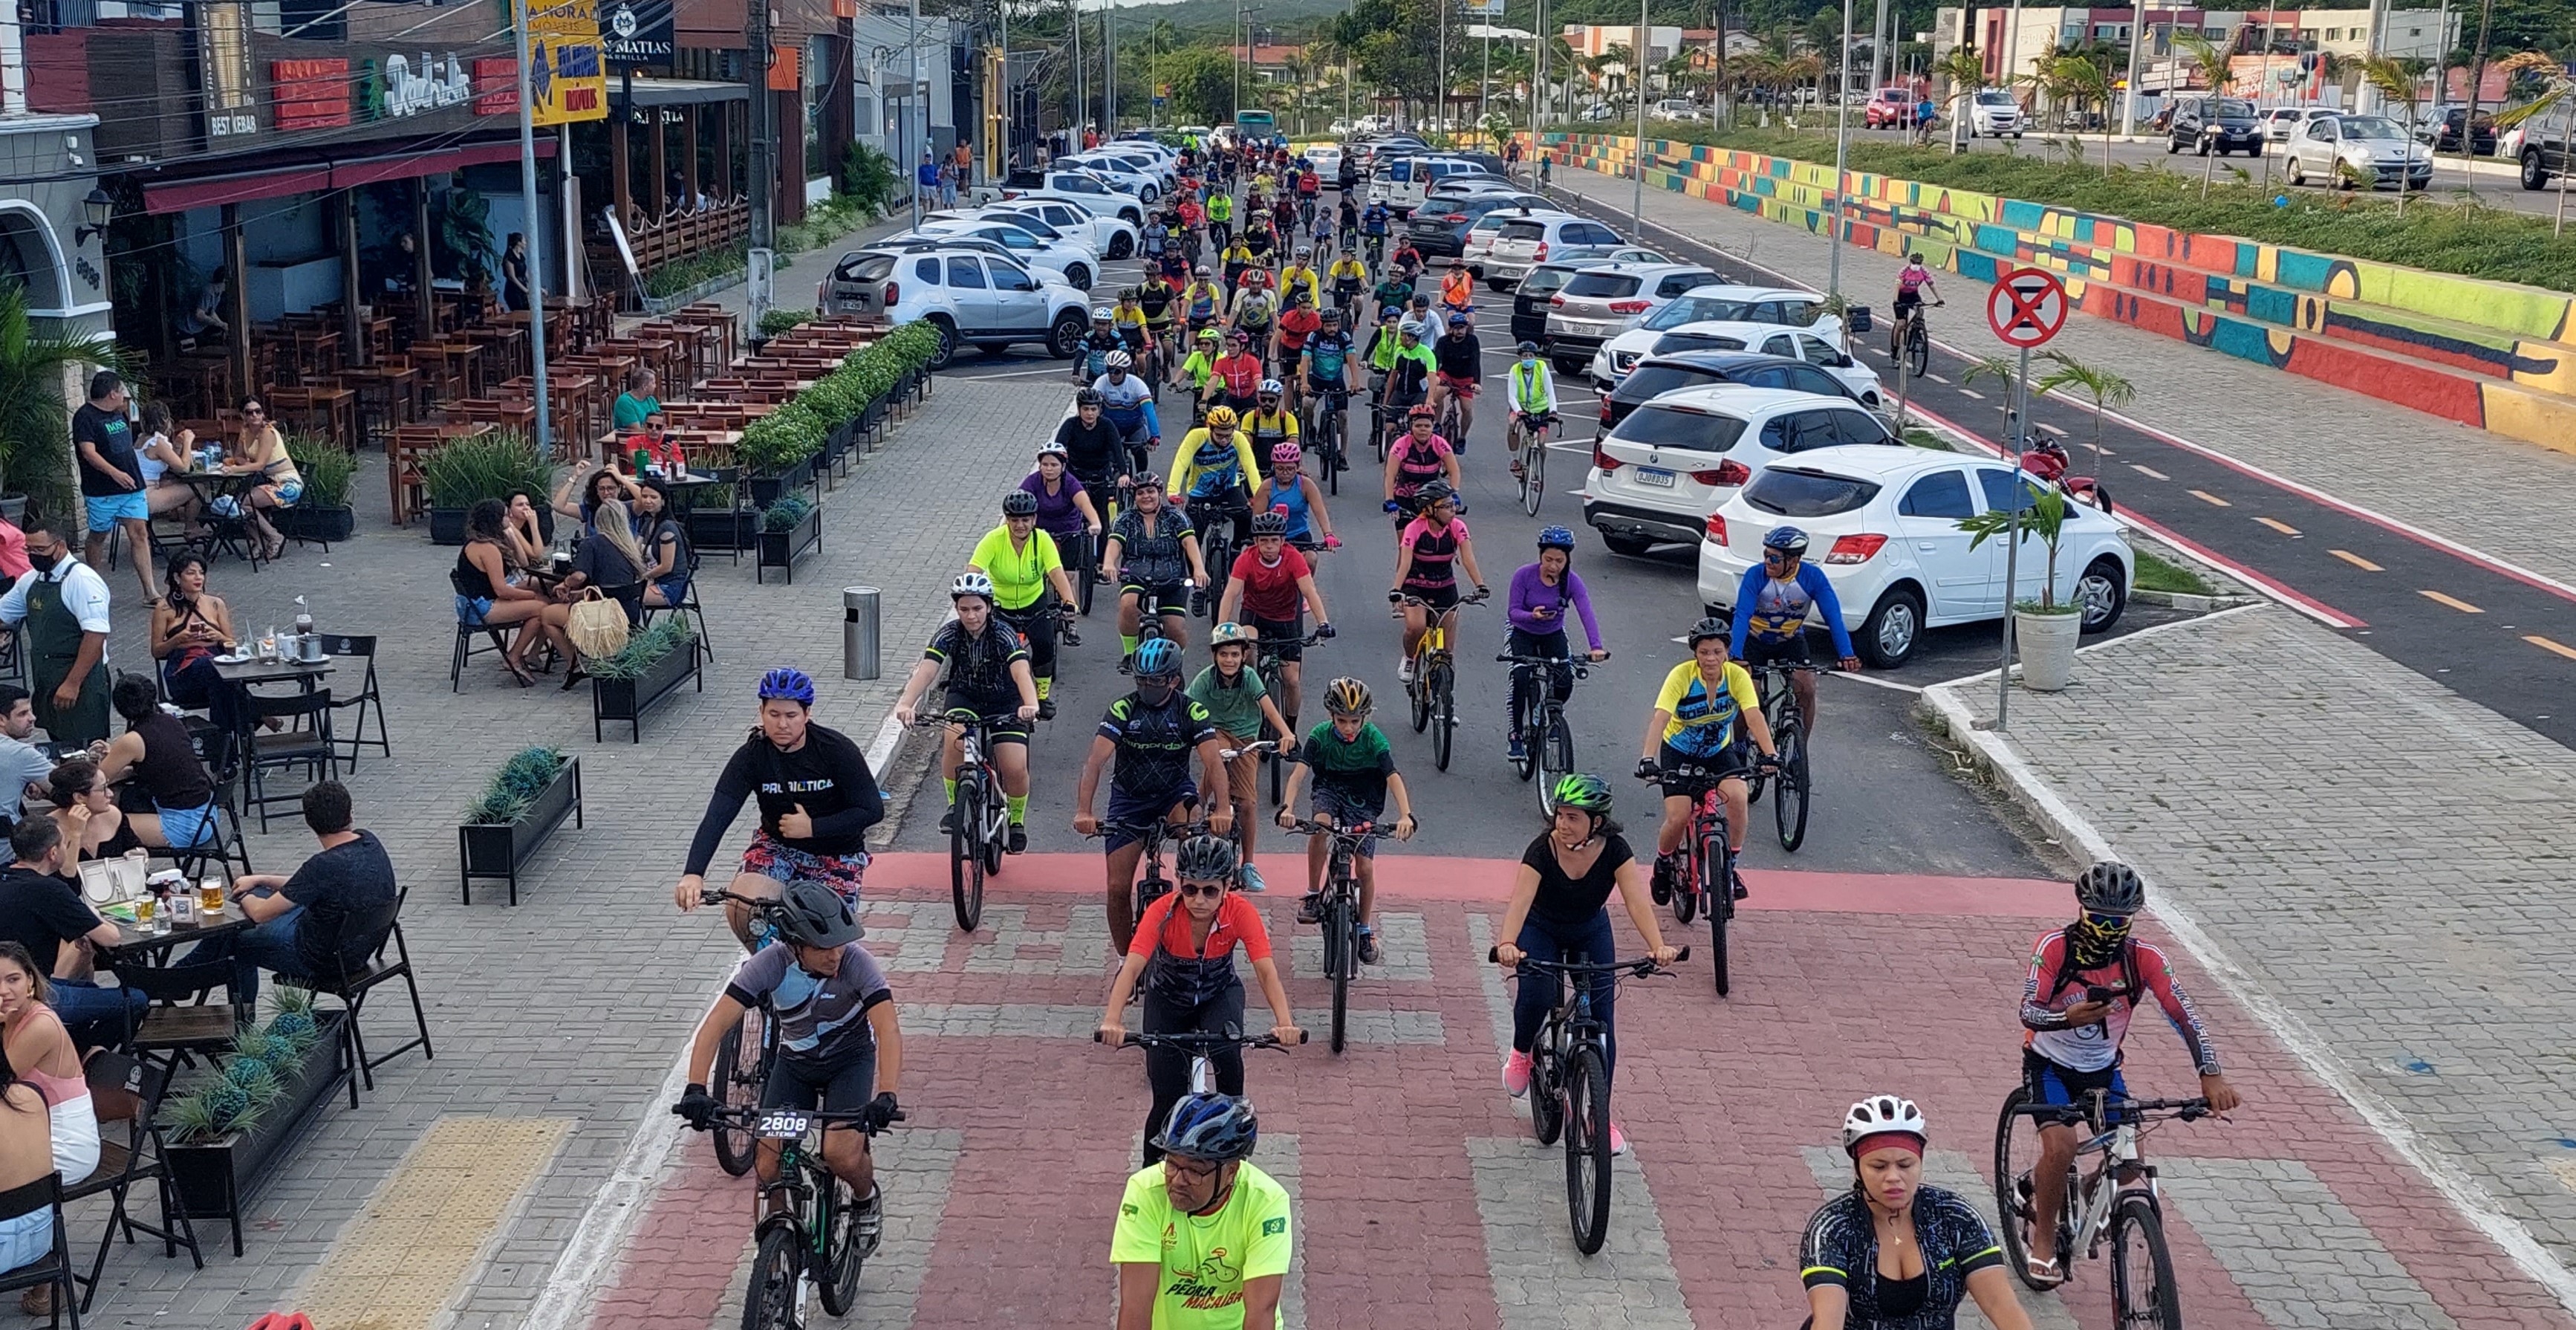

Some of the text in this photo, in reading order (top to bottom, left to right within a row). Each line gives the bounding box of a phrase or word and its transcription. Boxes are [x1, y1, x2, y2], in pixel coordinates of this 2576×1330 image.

[544, 5, 587, 19] HORA
[616, 40, 671, 54] MATIAS
[212, 114, 257, 135] BEST KEBAB
[759, 1117, 807, 1131] 2808
